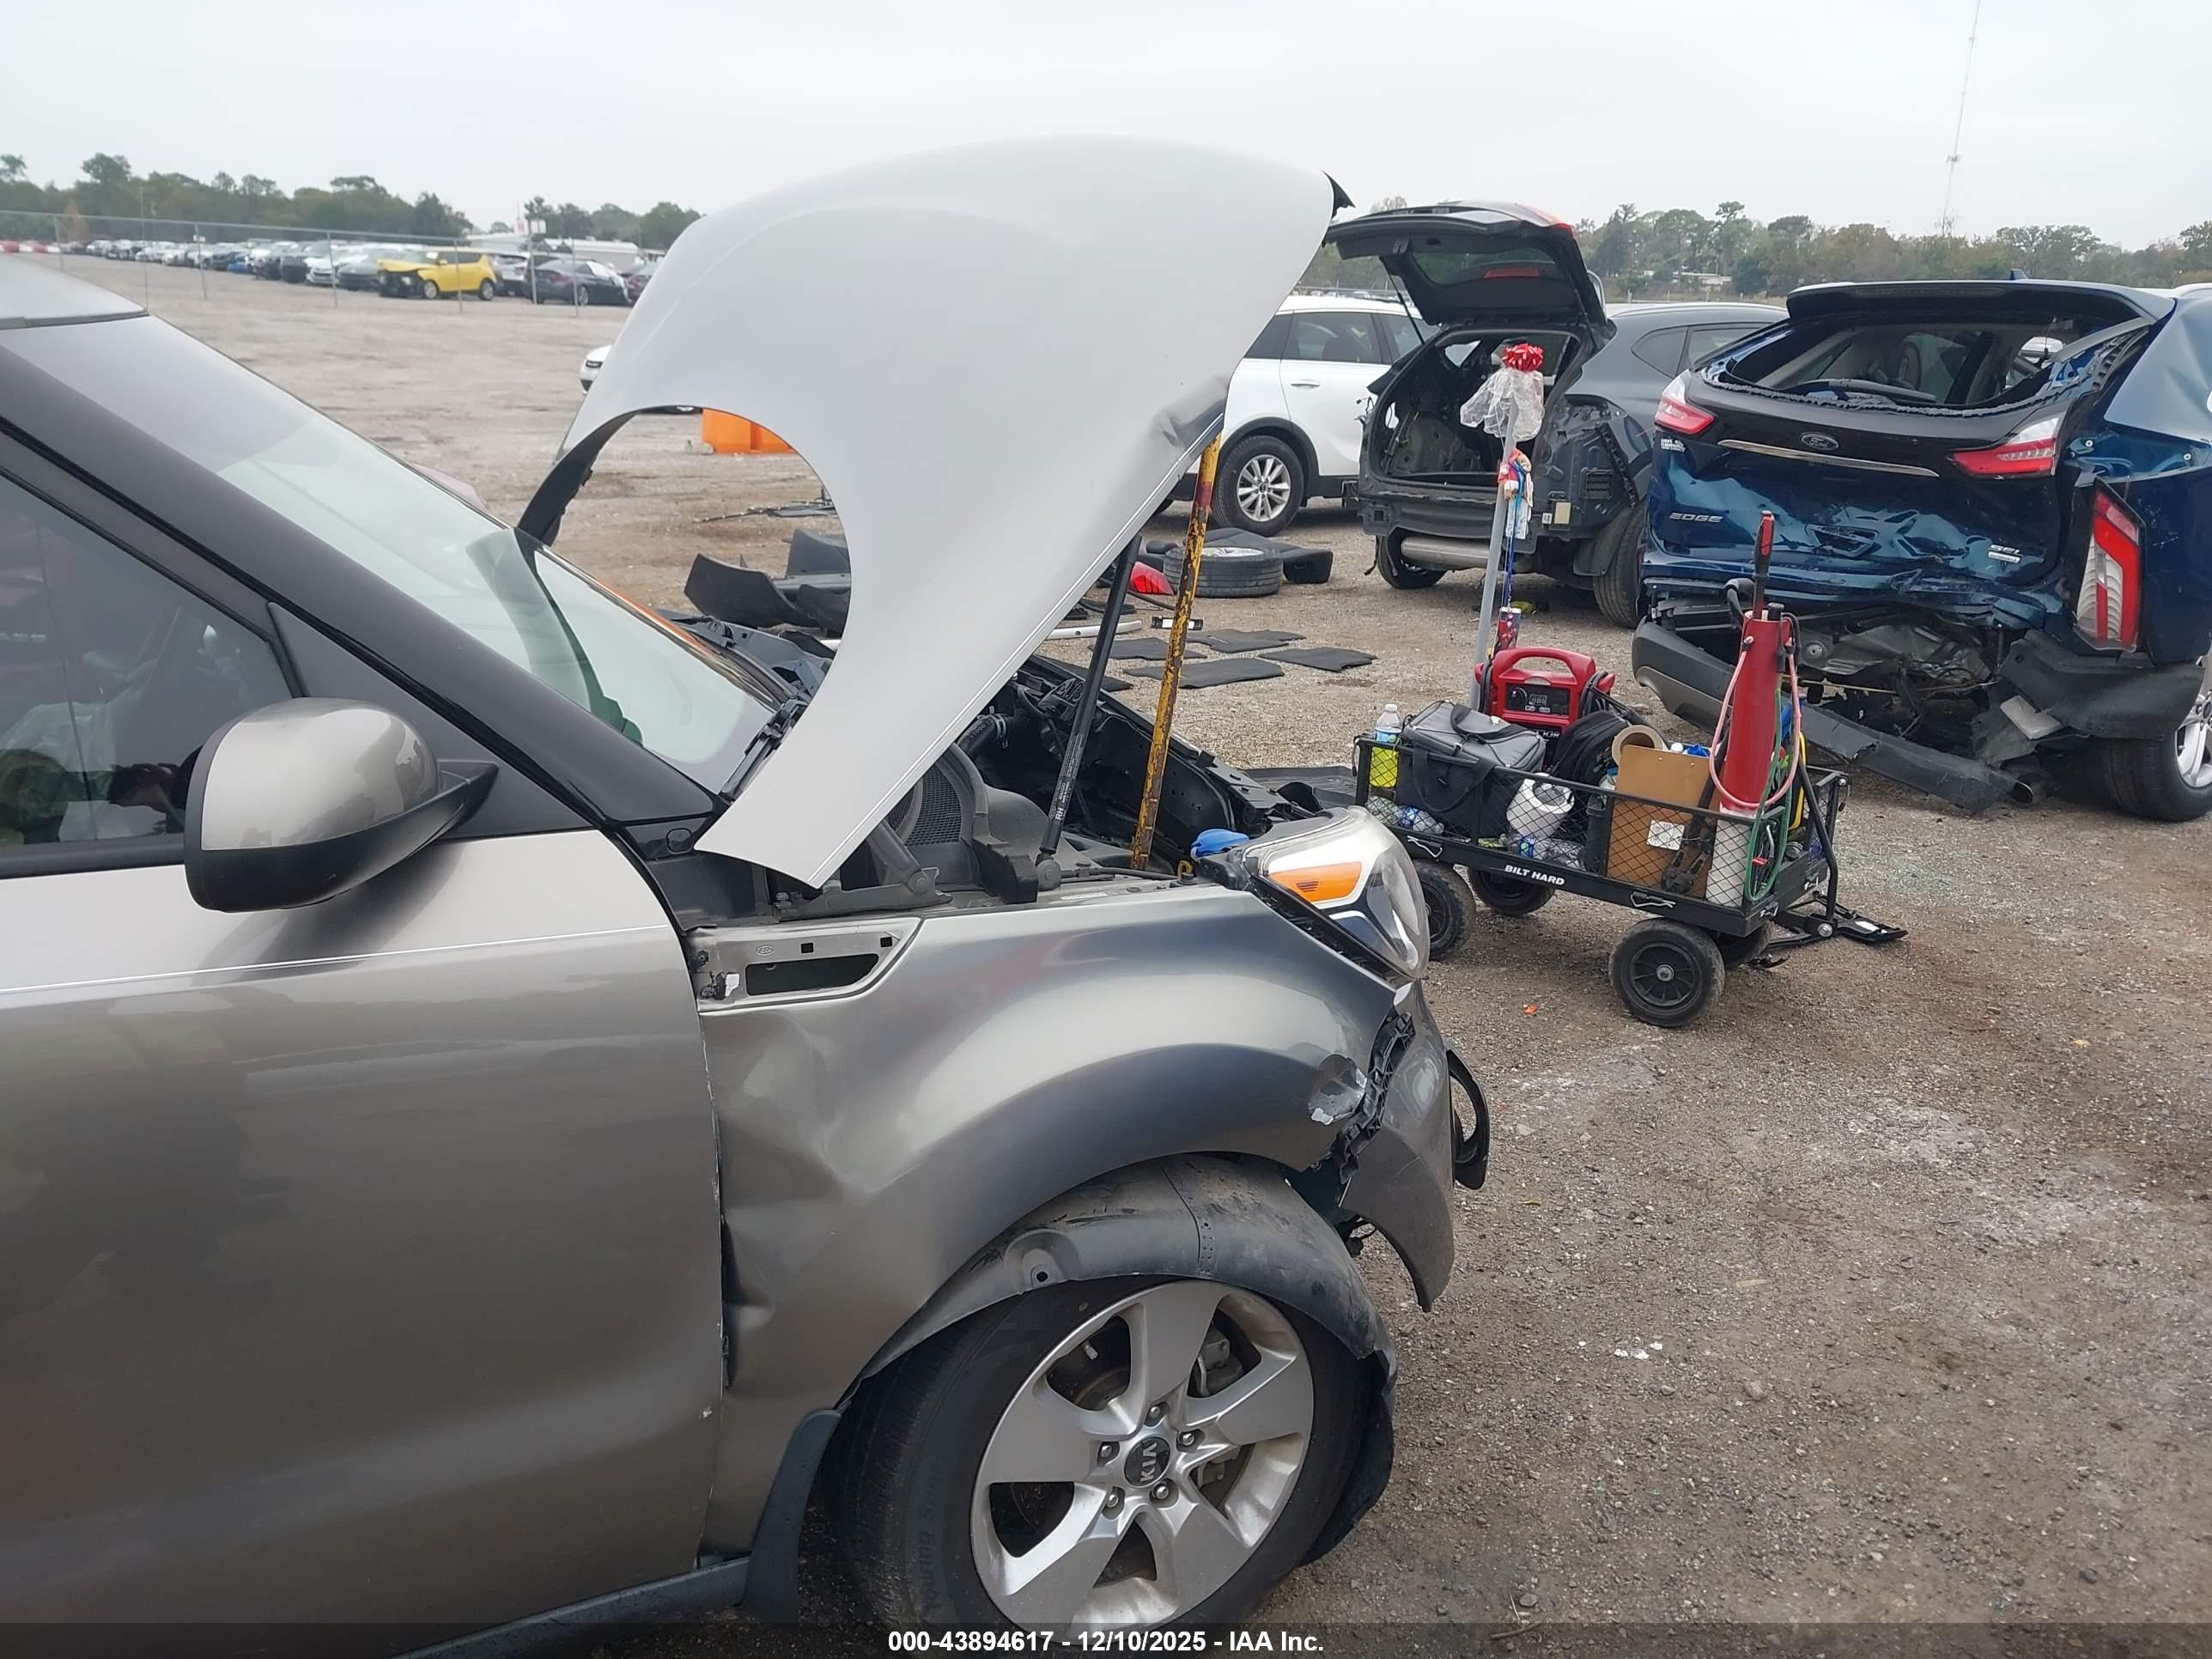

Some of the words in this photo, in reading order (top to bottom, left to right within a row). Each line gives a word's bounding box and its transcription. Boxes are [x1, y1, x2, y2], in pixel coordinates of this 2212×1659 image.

[1669, 513, 1723, 523] EDGE
[1988, 544, 2024, 557] SEL
[1054, 807, 1065, 821] RH
[1504, 865, 1530, 877] BILT
[1531, 872, 1565, 885] HARD
[1140, 1443, 1158, 1484] KIA
